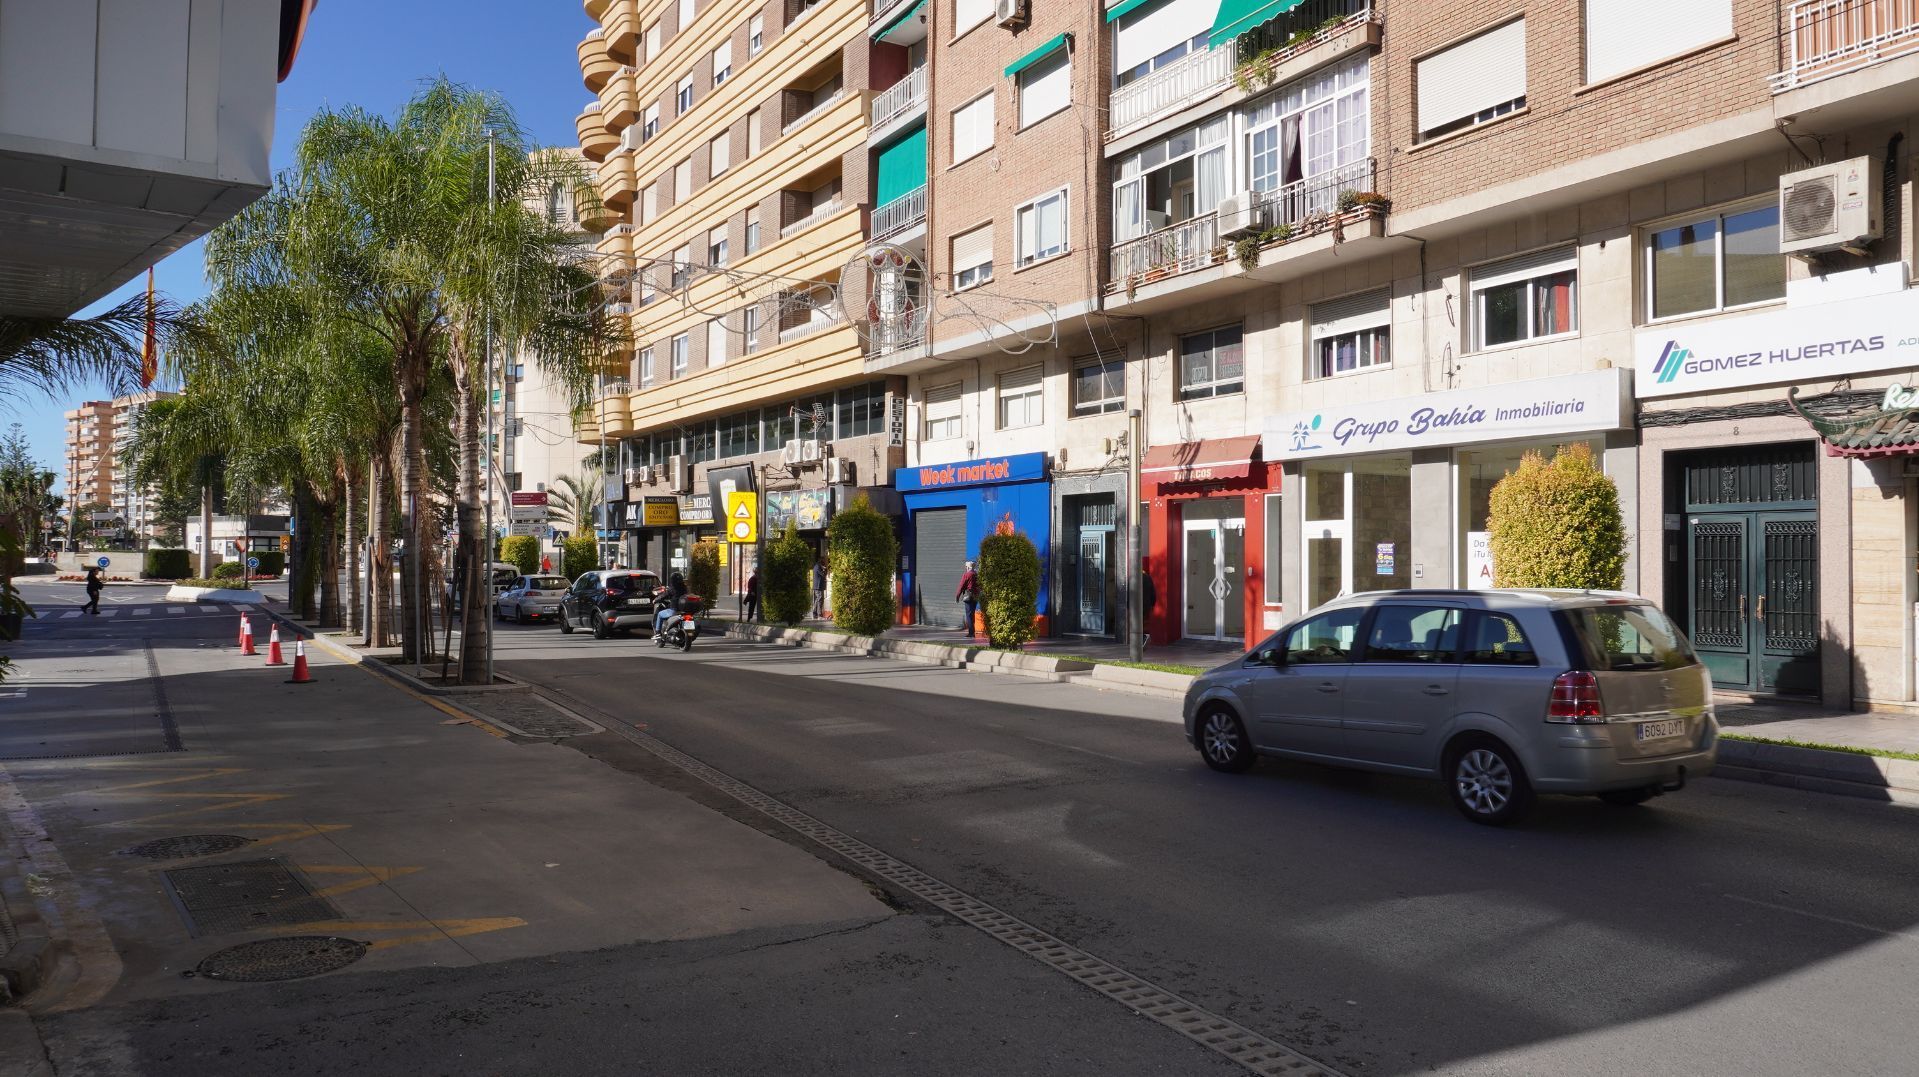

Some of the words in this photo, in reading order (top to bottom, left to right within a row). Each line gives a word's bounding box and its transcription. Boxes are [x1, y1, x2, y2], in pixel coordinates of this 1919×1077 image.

[1685, 353, 1762, 374] GOMEZ
[1769, 335, 1884, 364] HUERTAS
[892, 398, 903, 445] GESTORIA
[1333, 418, 1399, 446] Grupo
[1406, 404, 1487, 436] Bahía
[1494, 398, 1585, 421] Inmobiliaria
[1733, 426, 1740, 436] 8
[920, 465, 956, 487] Week
[957, 459, 1010, 483] market
[1645, 724, 1666, 738] 6092
[1668, 720, 1683, 735] DYT
